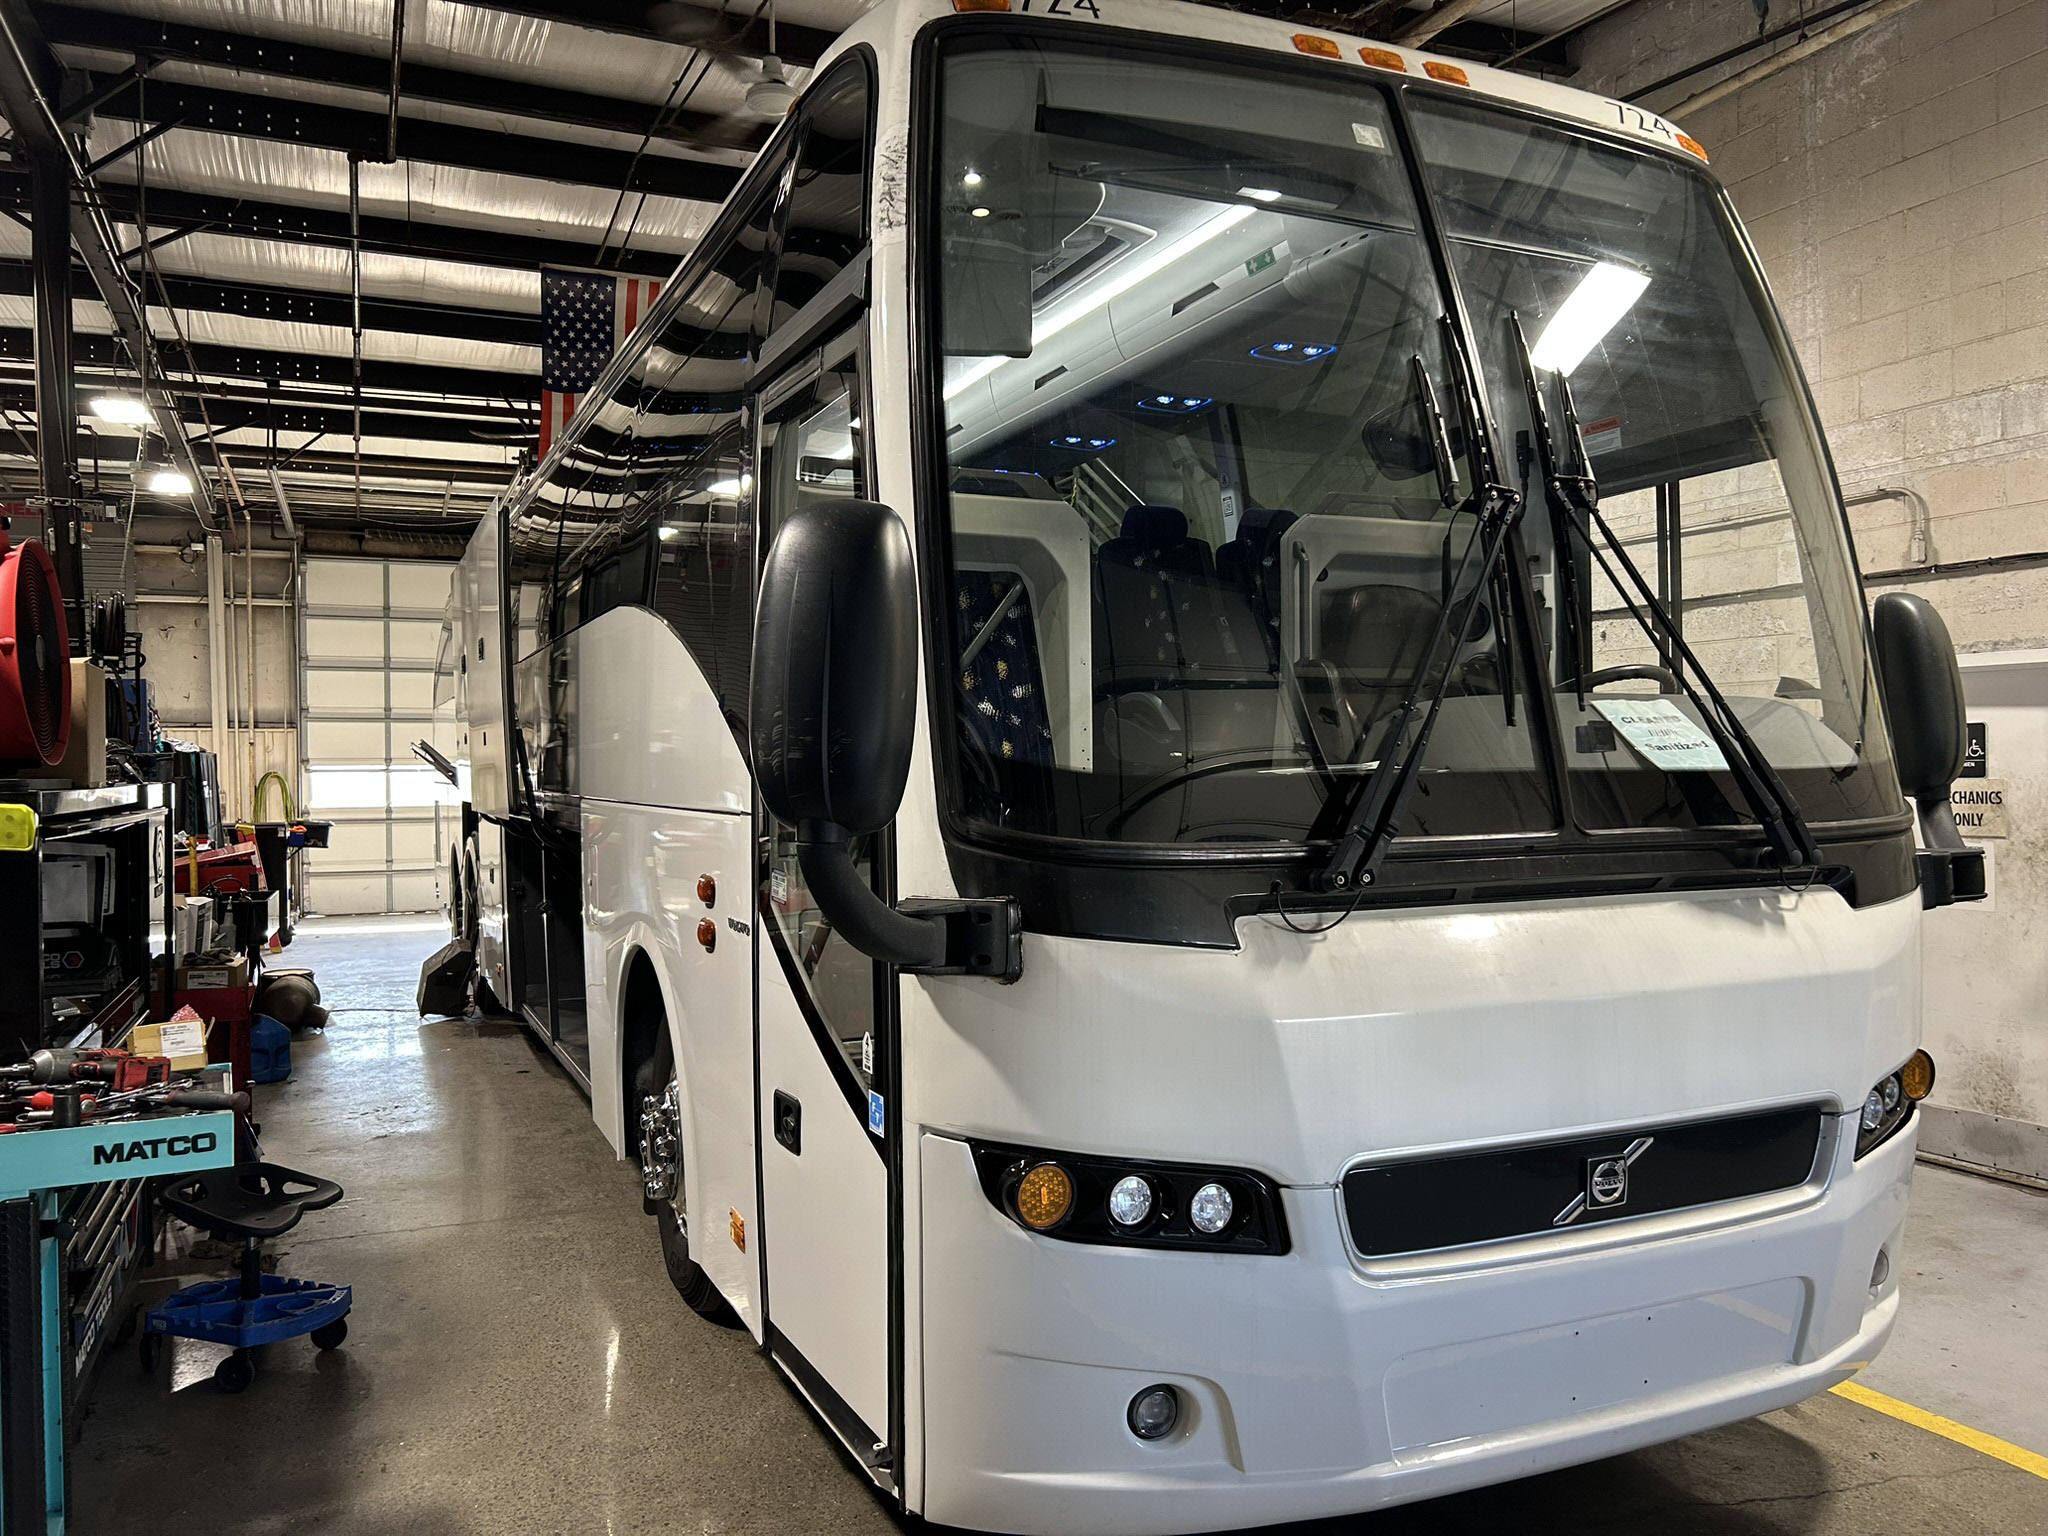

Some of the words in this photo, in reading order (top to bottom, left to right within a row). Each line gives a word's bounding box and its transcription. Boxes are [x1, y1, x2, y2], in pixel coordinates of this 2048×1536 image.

[1604, 101, 1671, 139] 724
[1950, 791, 2003, 805] CHANICS
[1953, 813, 1984, 826] ONLY
[94, 1132, 217, 1165] MATCO
[1594, 1177, 1624, 1187] VOLVO
